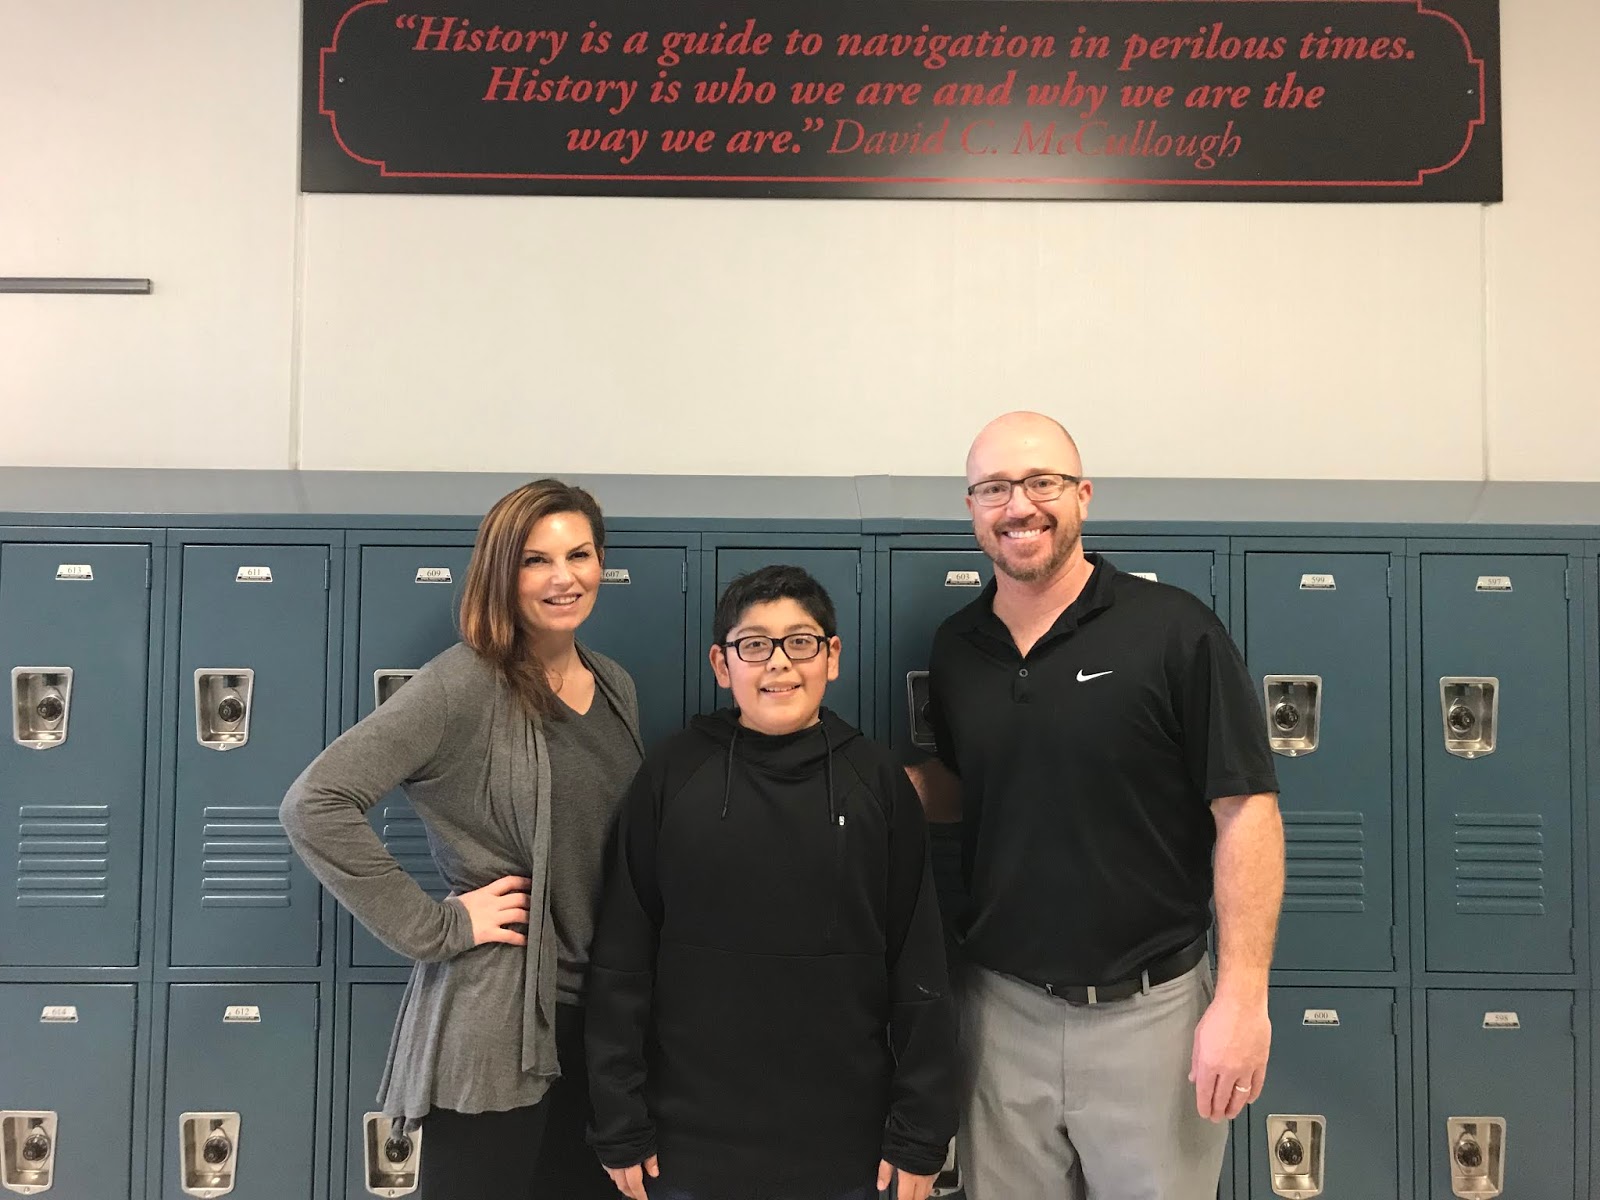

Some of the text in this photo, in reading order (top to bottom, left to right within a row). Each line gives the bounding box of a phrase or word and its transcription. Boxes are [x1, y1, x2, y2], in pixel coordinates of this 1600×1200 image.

[395, 16, 1415, 72] “History is a guide to navigation in perilous times.
[484, 66, 1326, 118] History is who we are and why we are the
[567, 117, 1241, 170] way we are.” David C. McCullough
[235, 1008, 250, 1016] 612
